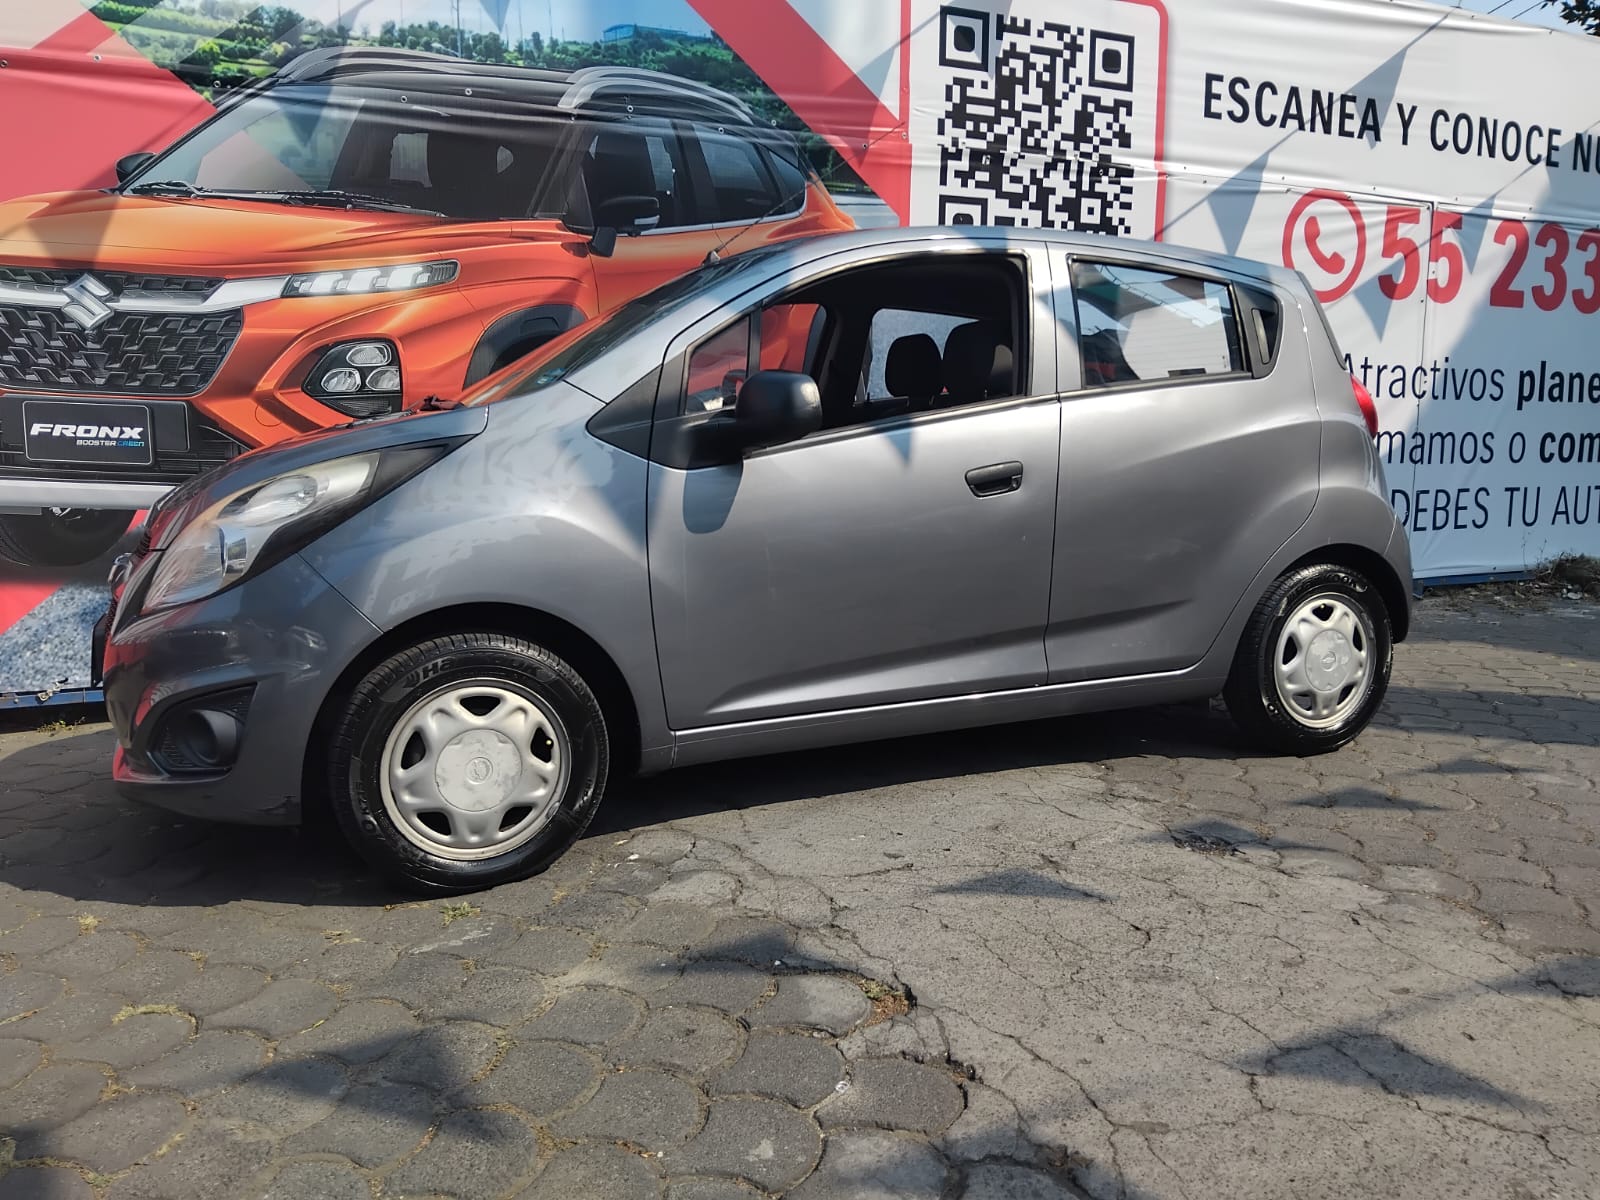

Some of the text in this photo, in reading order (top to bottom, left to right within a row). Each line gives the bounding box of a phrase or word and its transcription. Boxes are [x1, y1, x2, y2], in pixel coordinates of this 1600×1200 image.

[1203, 72, 1600, 176] ESCANEA Y CONOCE N
[1378, 205, 1600, 314] 55 233
[1516, 360, 1600, 411] plane
[30, 423, 144, 439] FRONX
[1508, 431, 1526, 464] o
[1539, 431, 1600, 463] com
[1504, 486, 1541, 528] TU
